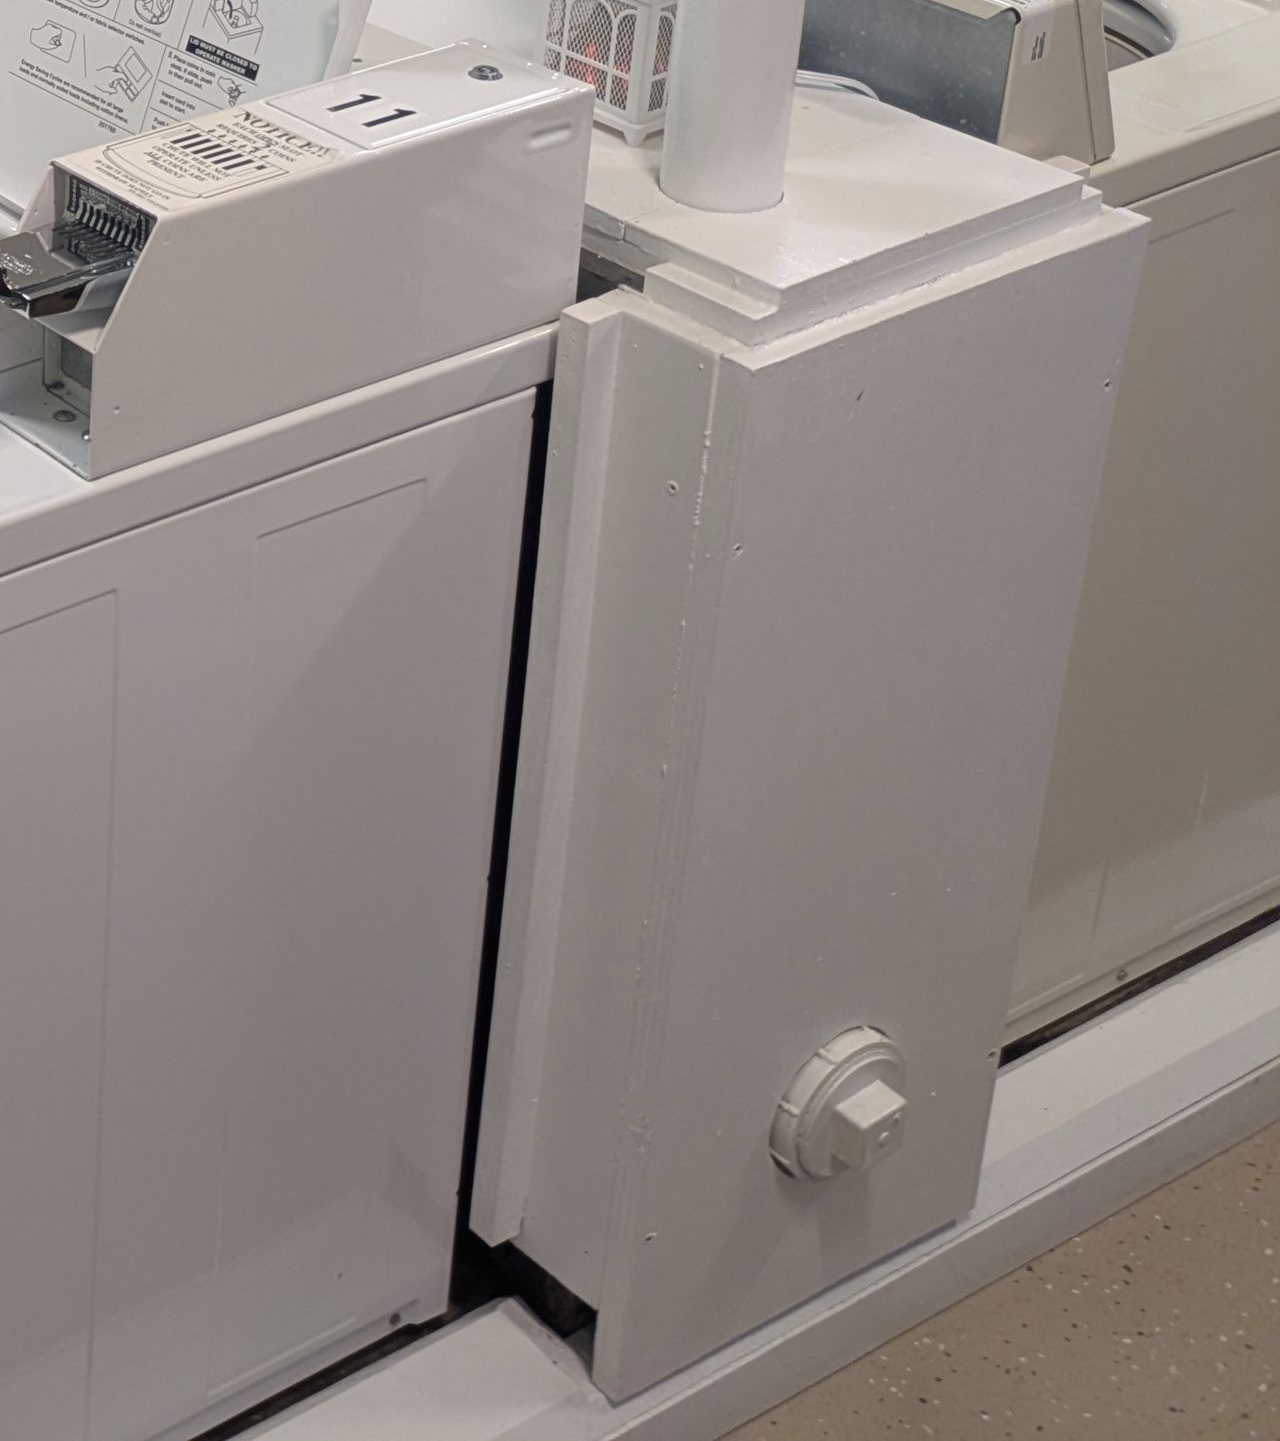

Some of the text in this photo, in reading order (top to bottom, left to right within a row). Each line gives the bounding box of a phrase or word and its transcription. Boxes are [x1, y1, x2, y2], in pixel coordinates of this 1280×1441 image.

[190, 37, 258, 71] LID MUST BE CLOSED TO
[221, 58, 246, 75] WASHER
[325, 92, 419, 131] 11
